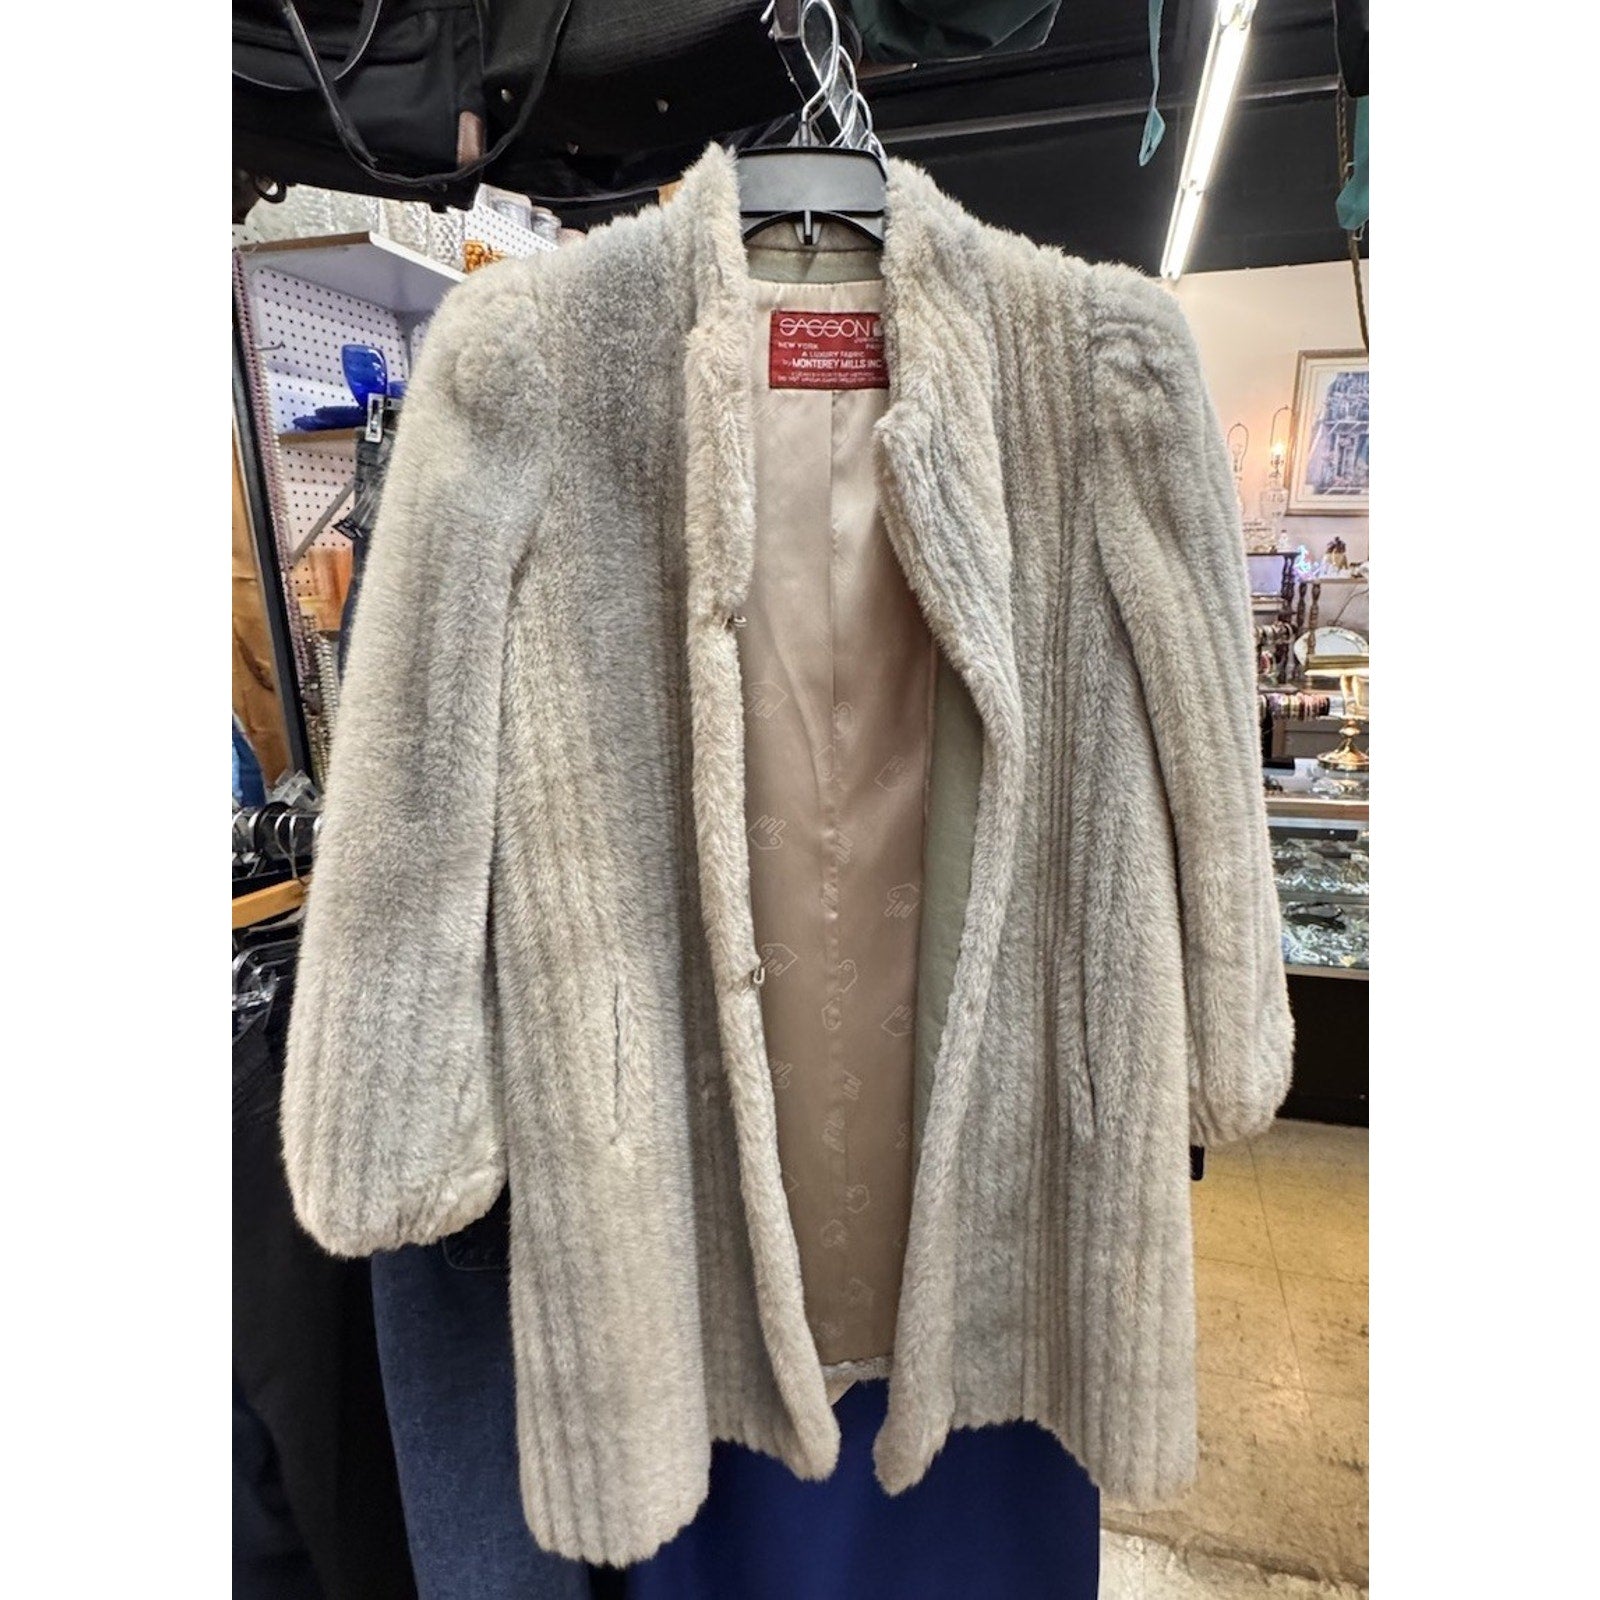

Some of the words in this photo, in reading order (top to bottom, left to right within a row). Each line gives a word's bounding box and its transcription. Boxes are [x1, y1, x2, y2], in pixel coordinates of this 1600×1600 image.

[779, 317, 870, 338] SASSON
[798, 342, 818, 350] YORK
[792, 358, 839, 369] MONTEREY
[840, 358, 866, 369] MILLS
